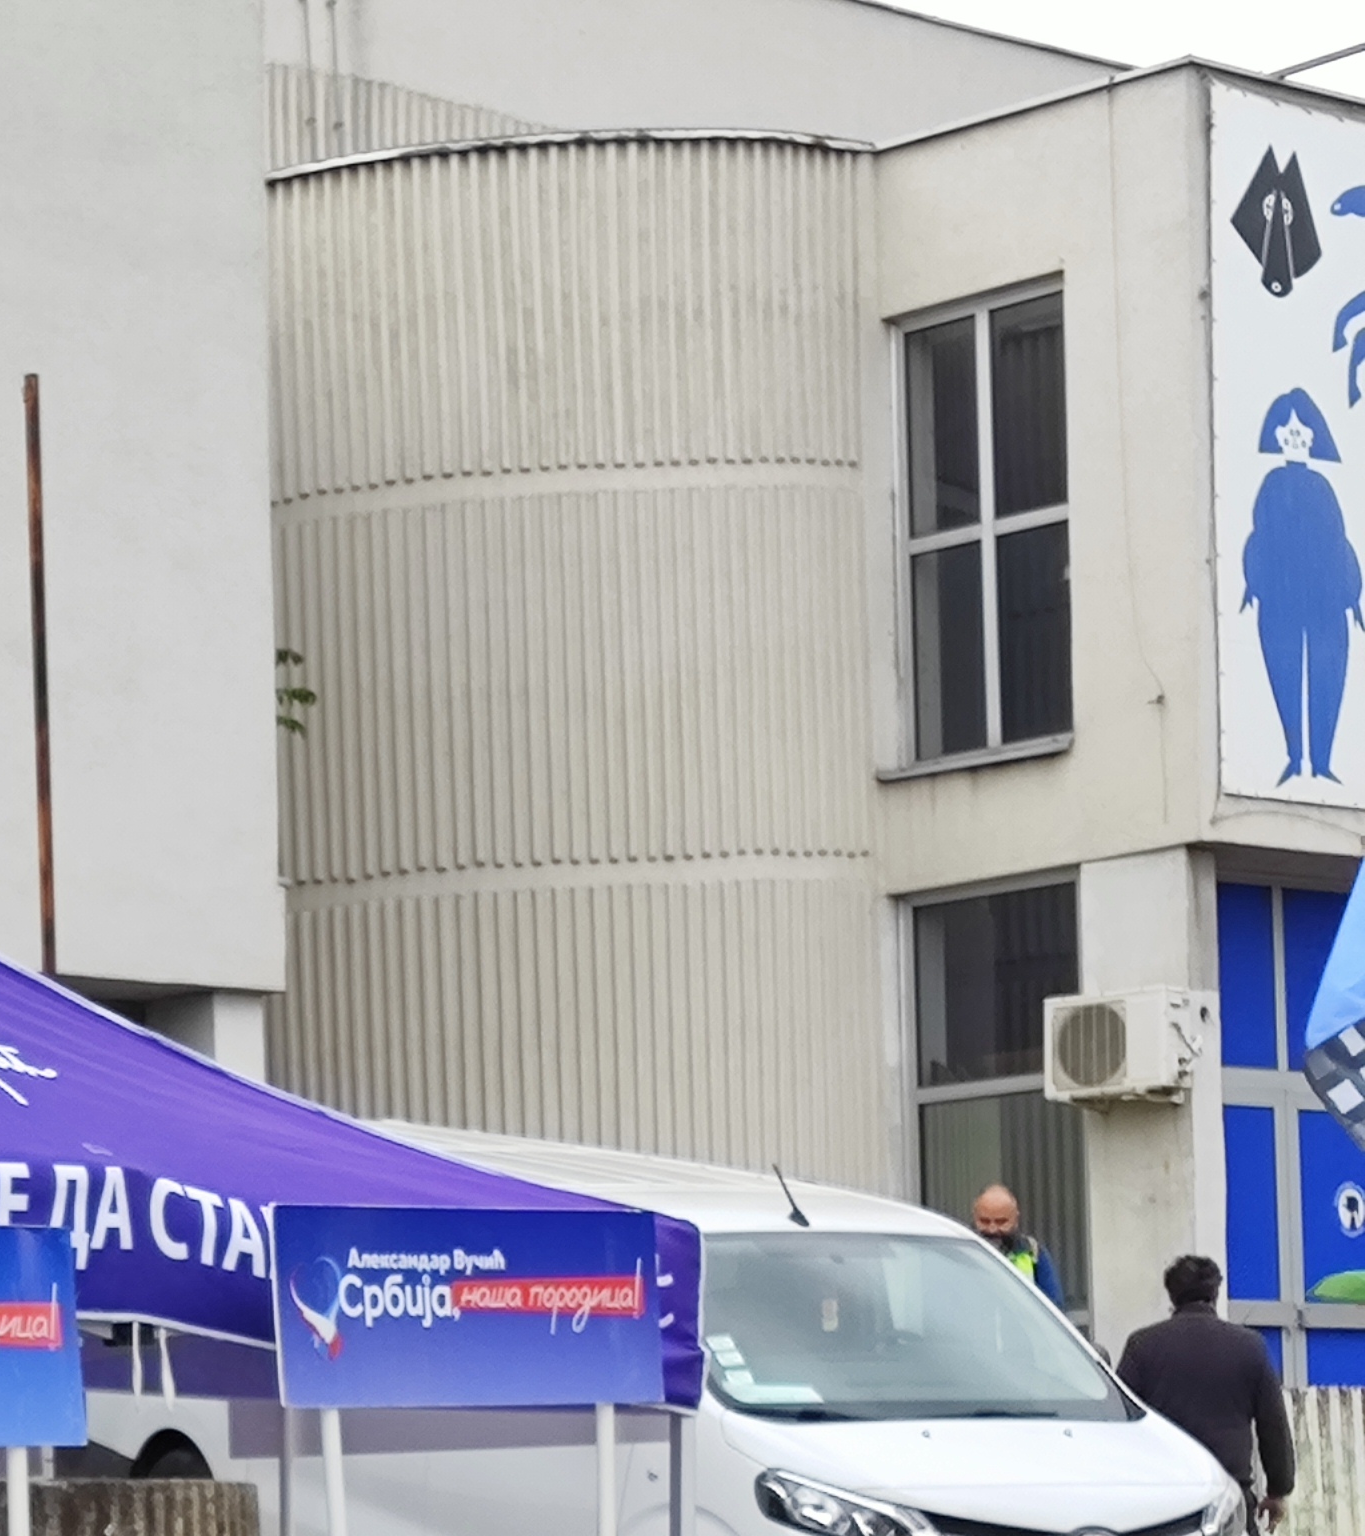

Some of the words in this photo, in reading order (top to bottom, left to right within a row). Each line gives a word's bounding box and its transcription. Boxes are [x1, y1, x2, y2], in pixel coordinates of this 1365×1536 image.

[49, 1164, 134, 1270] ДА
[149, 1176, 275, 1281] СТА
[347, 1247, 451, 1275] Александар
[453, 1248, 506, 1276] Вучић
[338, 1273, 460, 1328] Србија,
[460, 1284, 522, 1308] наша
